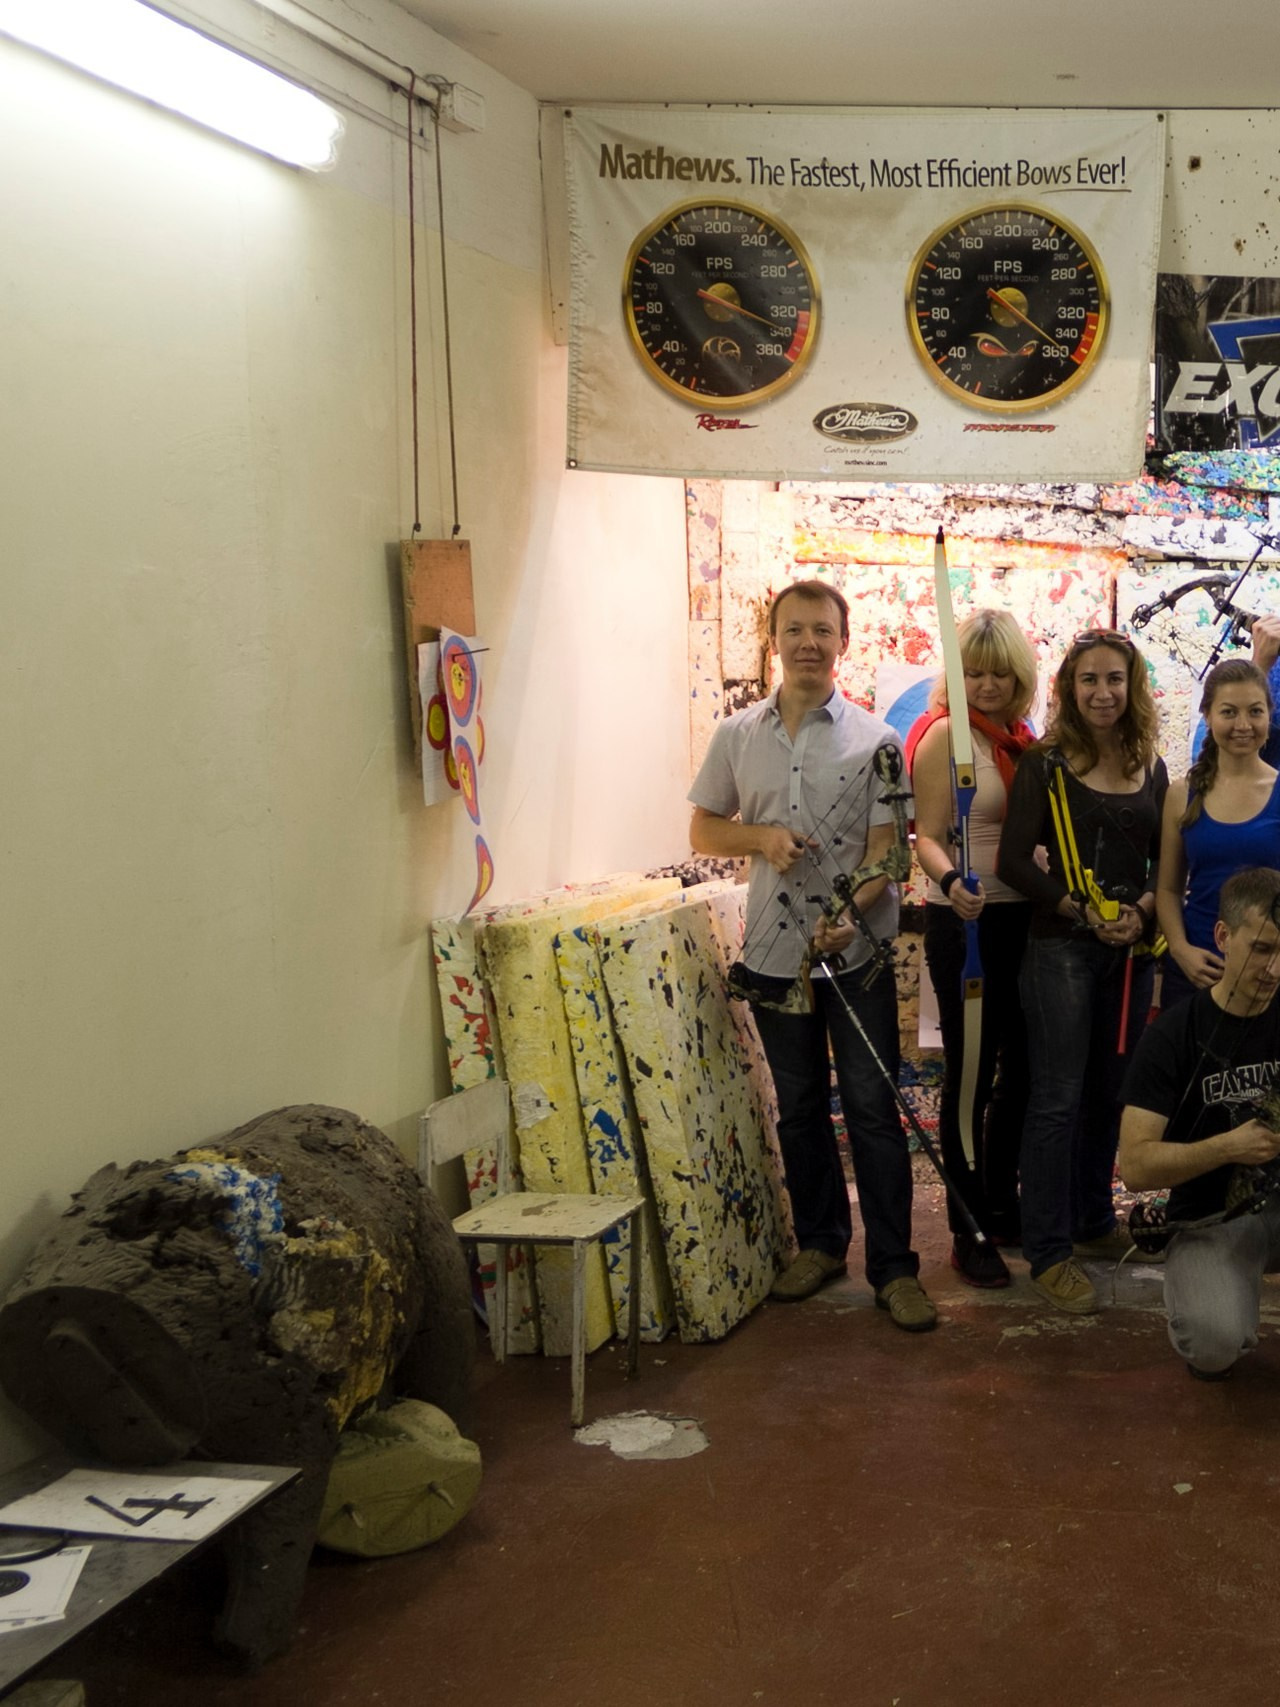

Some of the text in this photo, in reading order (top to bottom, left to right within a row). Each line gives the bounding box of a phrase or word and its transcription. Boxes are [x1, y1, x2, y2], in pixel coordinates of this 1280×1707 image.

[599, 144, 1126, 192] Mathews. The Fastest, Most Efficient Bows Ever!
[704, 222, 731, 234] 200
[994, 225, 1022, 237] 200
[1023, 229, 1038, 237] 220
[673, 234, 696, 246] 160
[741, 234, 767, 247] 240
[958, 237, 983, 249] 160
[1032, 238, 1059, 251] 240
[650, 262, 675, 275] 120
[706, 257, 733, 269] FPS
[994, 261, 1022, 273] FPS
[760, 265, 787, 278] 280
[936, 267, 962, 280] 120
[1051, 268, 1077, 281] 280
[1069, 288, 1084, 296] 300
[646, 302, 663, 314] 80
[770, 306, 797, 318] 320
[931, 307, 950, 320] 80
[1058, 307, 1085, 319] 320
[1055, 329, 1078, 338] 340
[662, 340, 680, 353] 40
[756, 343, 783, 356] 360
[948, 346, 966, 358] 40
[1042, 345, 1069, 358] 360
